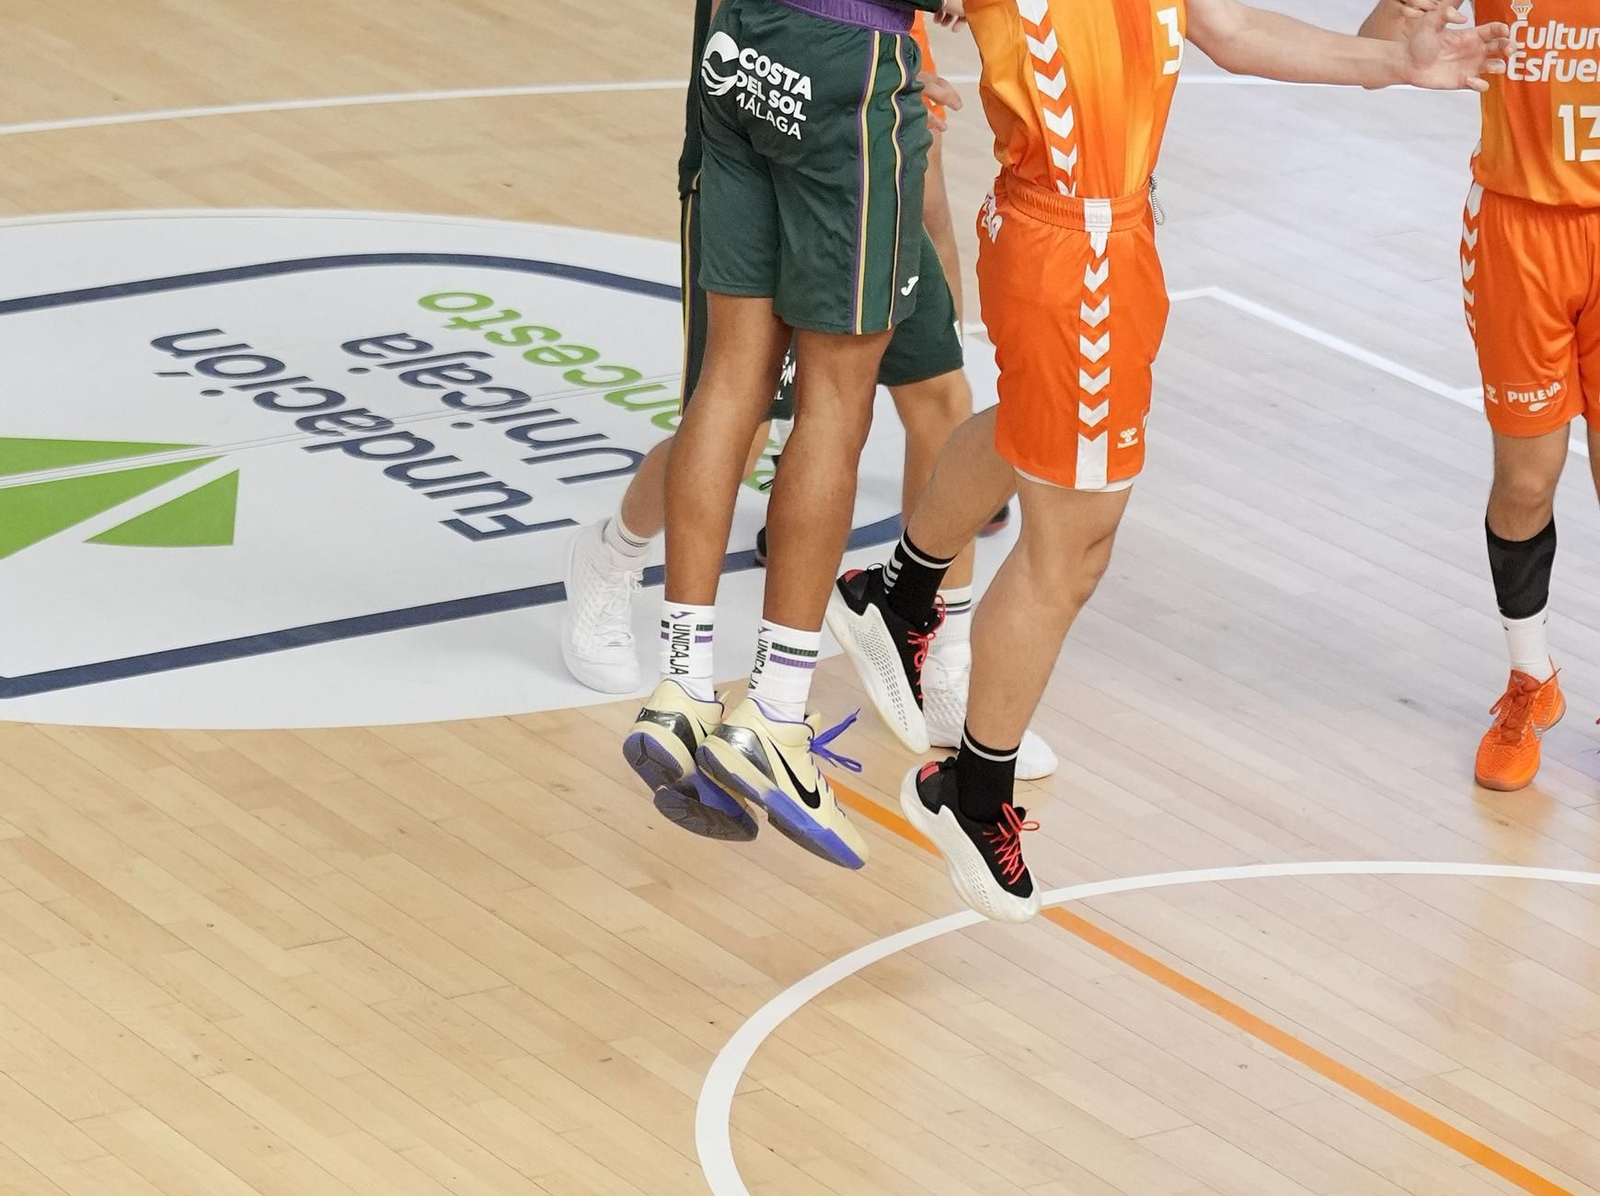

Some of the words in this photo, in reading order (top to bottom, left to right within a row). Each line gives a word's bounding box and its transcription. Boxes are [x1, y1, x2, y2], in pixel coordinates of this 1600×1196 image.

[1156, 7, 1184, 75] 3
[1510, 20, 1600, 51] Cultur
[736, 69, 766, 101] DEL
[768, 89, 807, 122] SOL
[739, 48, 812, 101] COSTA
[341, 332, 643, 485] Unicaja
[1507, 381, 1562, 403] PULEVA
[150, 328, 580, 542] Fundación
[669, 623, 691, 675] UNICAJA
